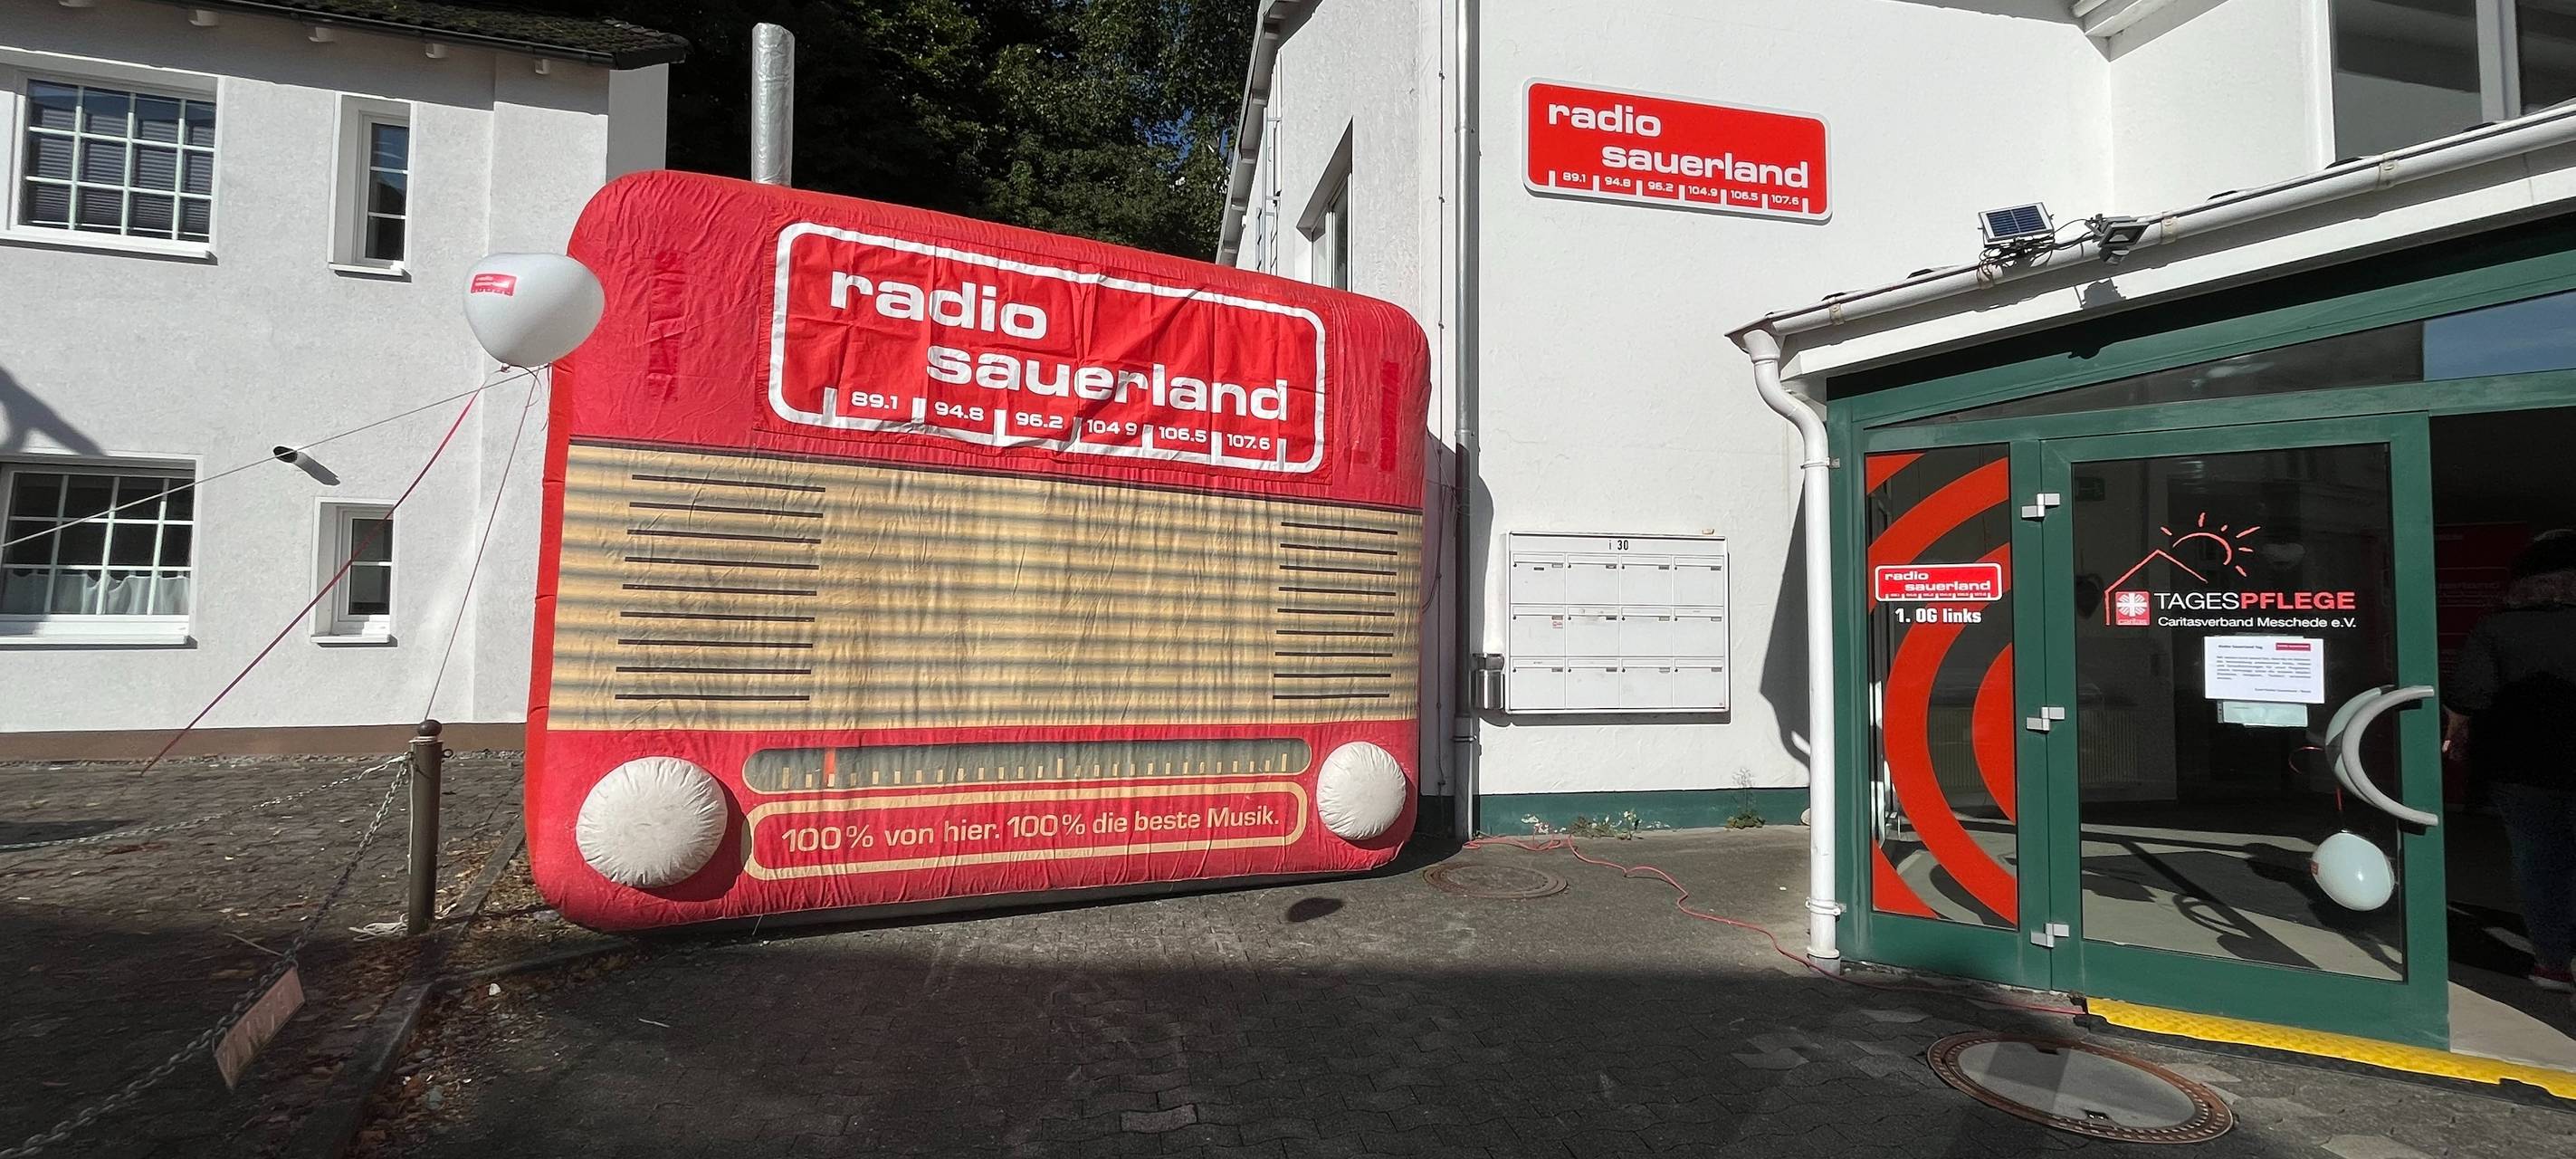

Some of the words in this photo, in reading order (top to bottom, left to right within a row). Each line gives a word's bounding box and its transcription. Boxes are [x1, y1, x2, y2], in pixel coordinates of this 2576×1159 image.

[1548, 103, 1661, 138] radio
[1601, 145, 1808, 188] sauerland
[1562, 172, 1586, 183] 89.1
[1604, 177, 1631, 187] 94.8
[1647, 181, 1674, 192] 96.2
[1688, 186, 1718, 196] 104.9
[1730, 190, 1758, 201] 106.5
[1771, 194, 1799, 205] 107.6
[830, 271, 1047, 340] radio
[926, 345, 1287, 421] sauerland
[851, 391, 898, 410] 89.1
[934, 401, 984, 421] 94.8
[1015, 412, 1064, 429] 96.2
[1158, 426, 1207, 443] 106.5
[1226, 433, 1271, 450] 107.6
[1617, 540, 1629, 551] 30
[1884, 570, 1929, 580] radio
[1904, 580, 1991, 591] sauerland
[1894, 608, 1911, 623] 1.
[1915, 608, 1938, 623] OG
[1942, 608, 1982, 623] links
[2154, 592, 2355, 610] TAGESPFLEGE
[2157, 617, 2254, 627] Caritasverband
[2257, 617, 2327, 627] Meschede
[2331, 618, 2356, 628] e.V.
[884, 828, 934, 847] von
[943, 819, 999, 843] hier.
[1092, 811, 1128, 834] die
[1134, 810, 1200, 832] beste
[1207, 805, 1279, 829] Musik.
